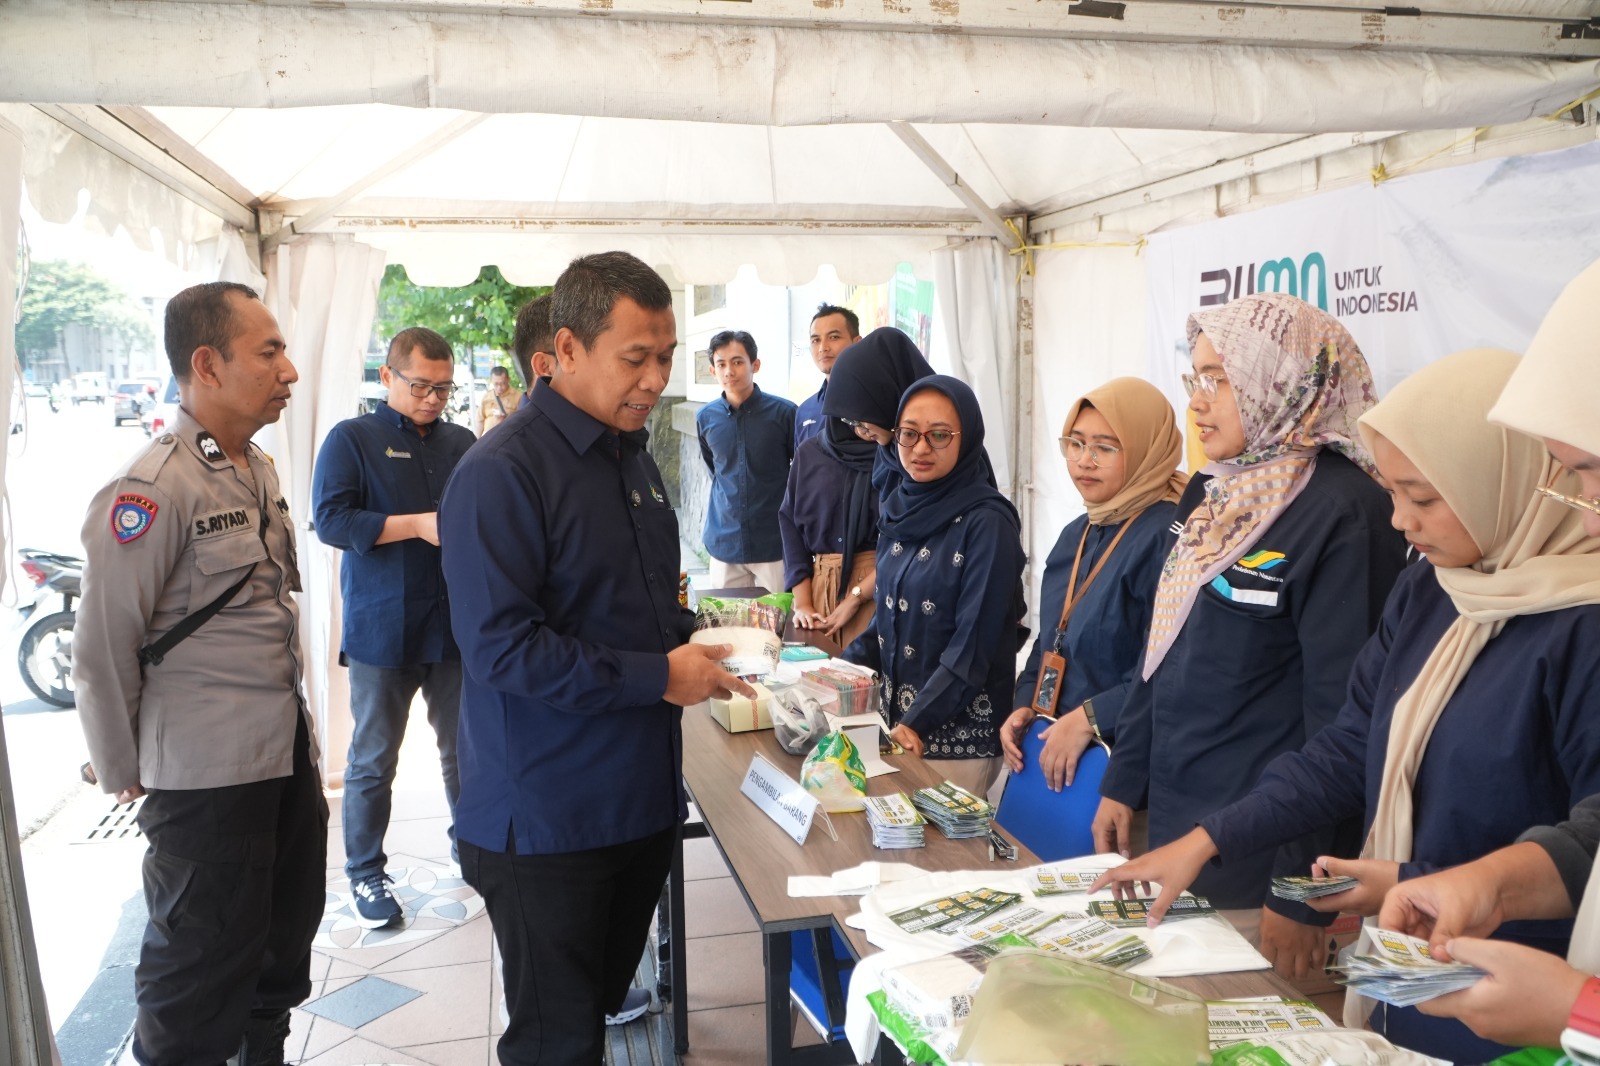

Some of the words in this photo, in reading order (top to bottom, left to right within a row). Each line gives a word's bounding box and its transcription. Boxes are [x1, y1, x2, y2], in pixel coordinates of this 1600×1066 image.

[1334, 265, 1383, 291] UNTUK
[1336, 291, 1419, 318] INDONESIA
[195, 510, 249, 535] S.RIYADI
